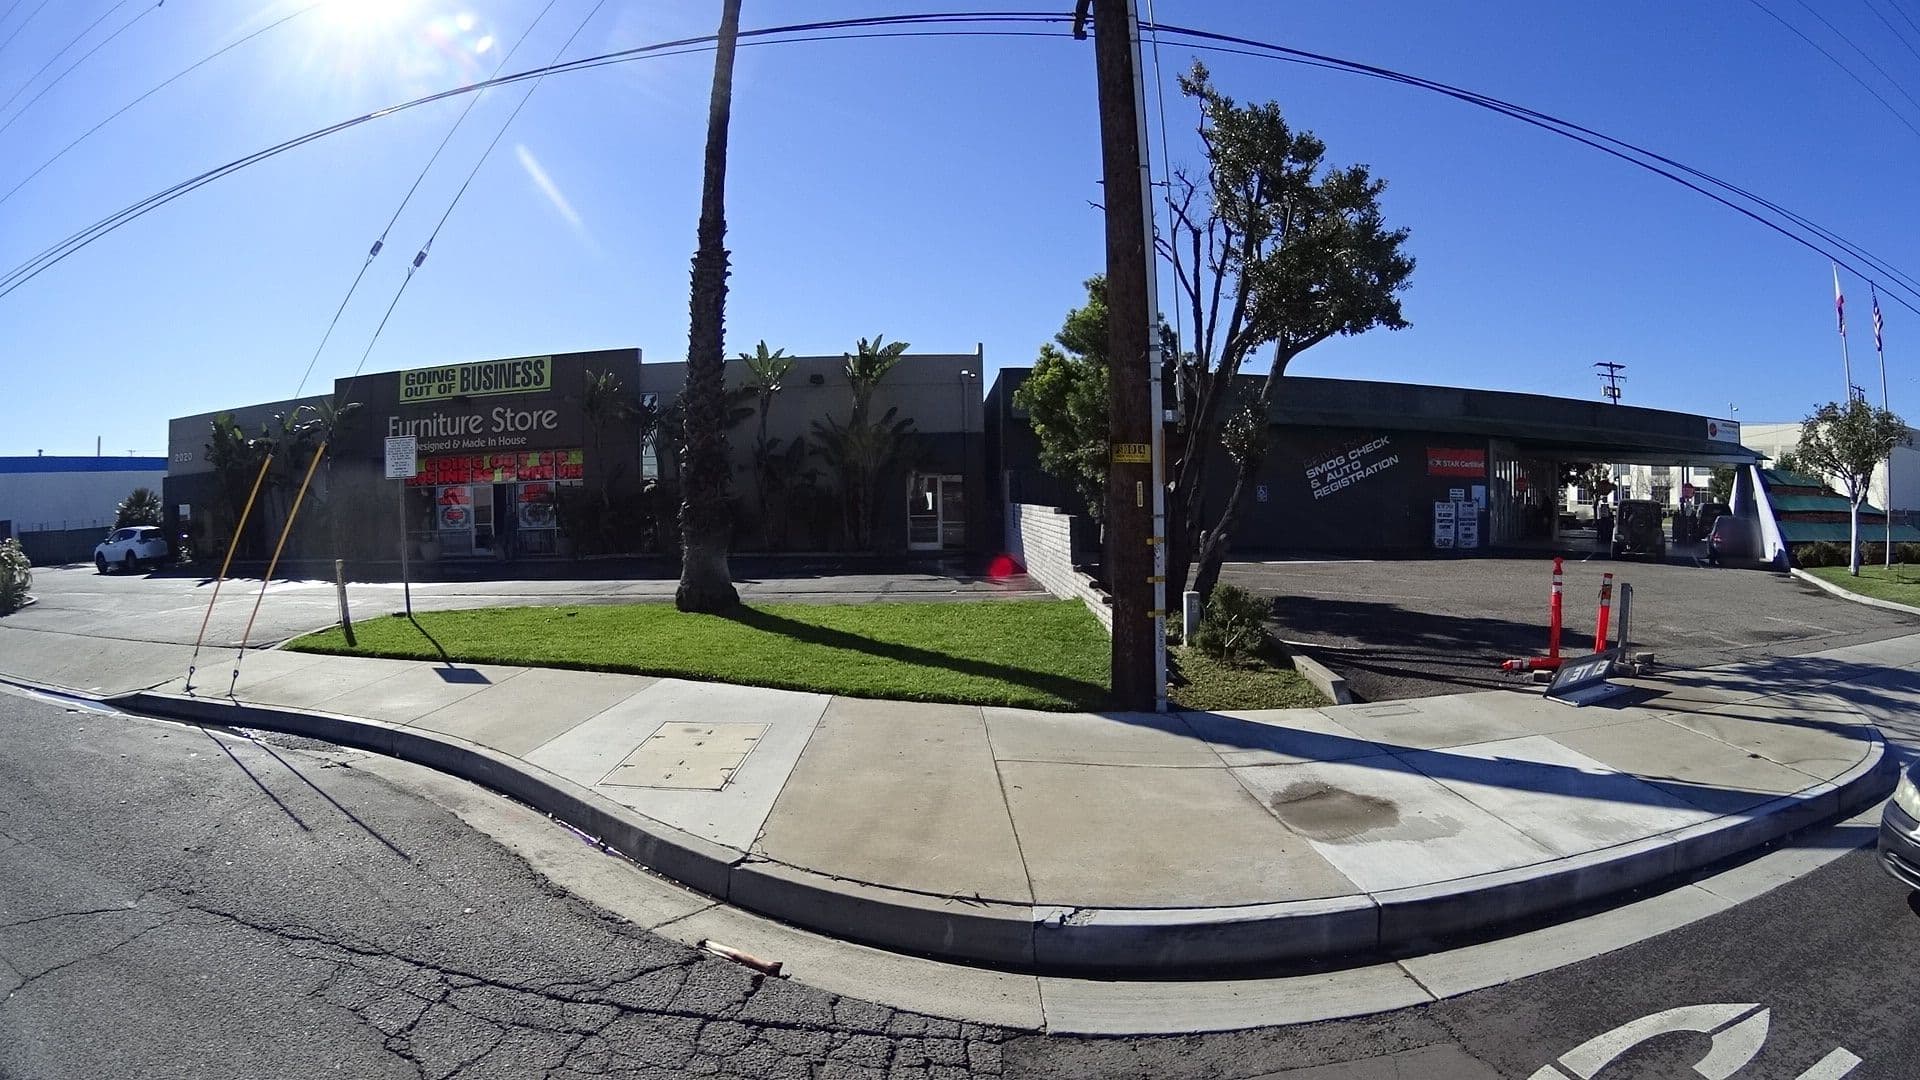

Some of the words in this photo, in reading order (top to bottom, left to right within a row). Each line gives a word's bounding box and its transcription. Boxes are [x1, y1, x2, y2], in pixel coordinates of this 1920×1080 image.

[404, 384, 433, 398] OUT
[437, 382, 456, 395] OF
[405, 368, 456, 386] GOING
[460, 358, 545, 393] BUSINESS
[388, 411, 484, 437] Furniture
[491, 406, 558, 433] Store
[452, 439, 461, 449] &
[462, 437, 486, 449] Made
[488, 435, 497, 447] In
[499, 434, 527, 447] House
[1306, 455, 1346, 479] SMOG
[1348, 435, 1391, 460] CHECK
[1310, 478, 1321, 489] &
[1326, 460, 1361, 482] AUTO
[1313, 454, 1399, 500] REGISTRATION
